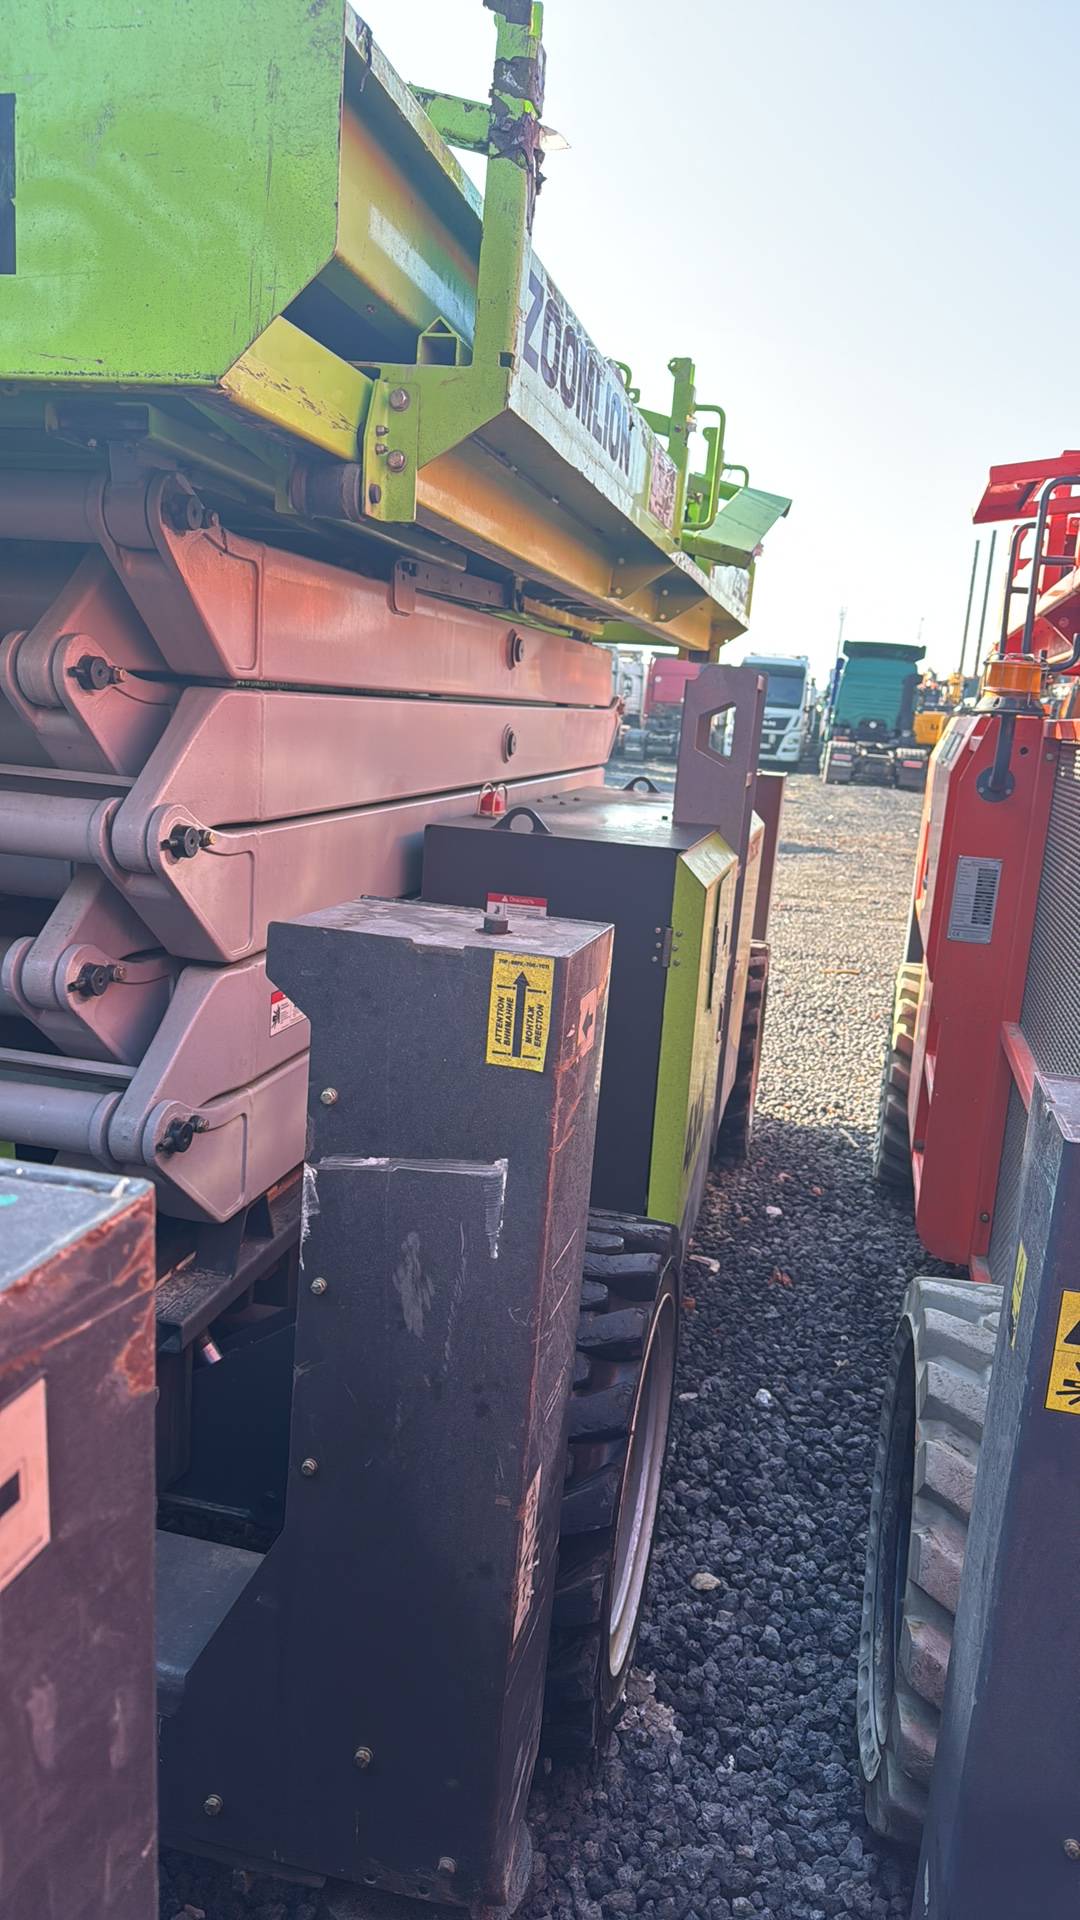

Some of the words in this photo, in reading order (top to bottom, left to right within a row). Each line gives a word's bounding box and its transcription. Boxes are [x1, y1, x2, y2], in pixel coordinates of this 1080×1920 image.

[523, 269, 633, 477] ZOOMLION
[495, 996, 505, 1045] ATTENTION
[503, 997, 514, 1047] ВНИМАНИЕ
[525, 1005, 535, 1045] МОНТАЖ
[533, 1004, 545, 1048] ERECTION
